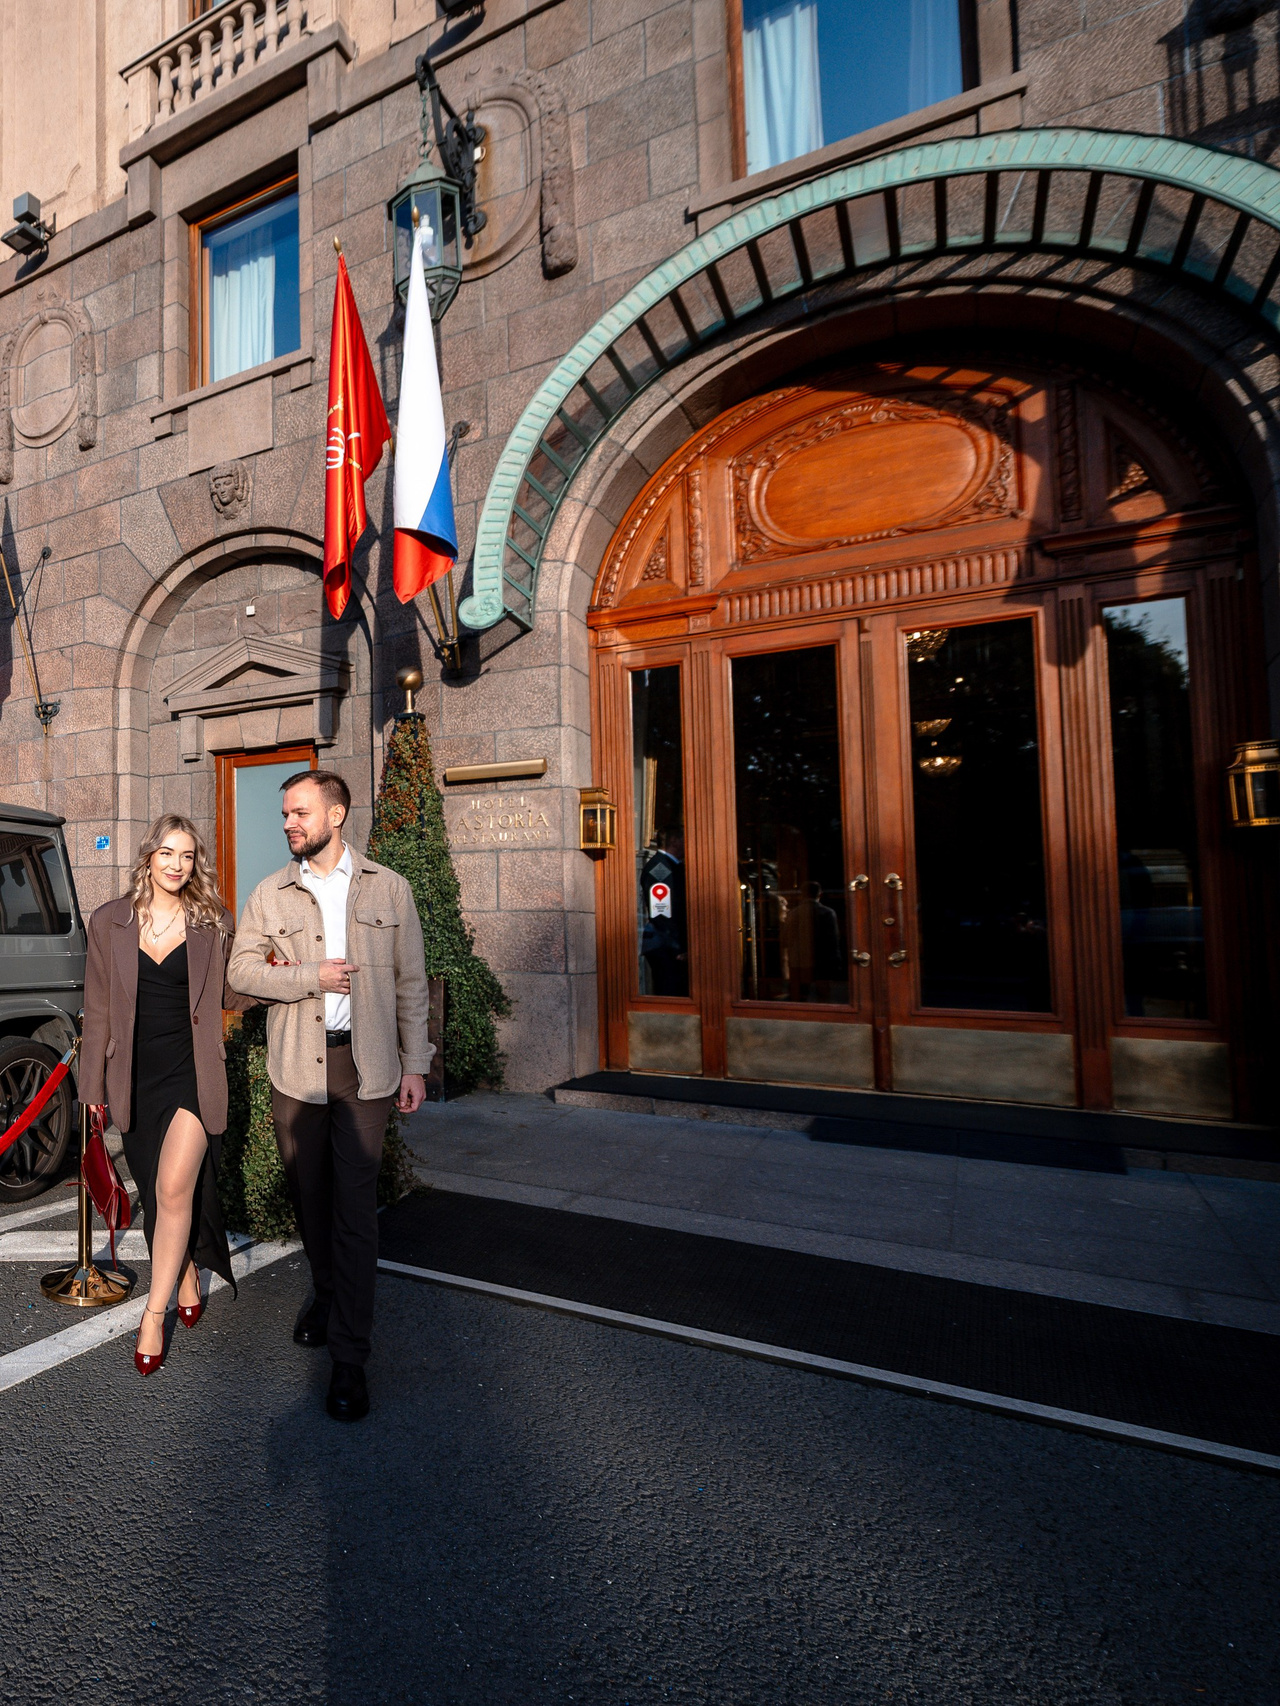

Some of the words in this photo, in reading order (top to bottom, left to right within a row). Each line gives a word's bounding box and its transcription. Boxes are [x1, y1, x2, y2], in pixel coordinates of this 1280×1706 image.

[471, 796, 527, 810] HOTEL
[455, 812, 549, 831] ASTORIA
[452, 830, 551, 845] RESTAURANT
